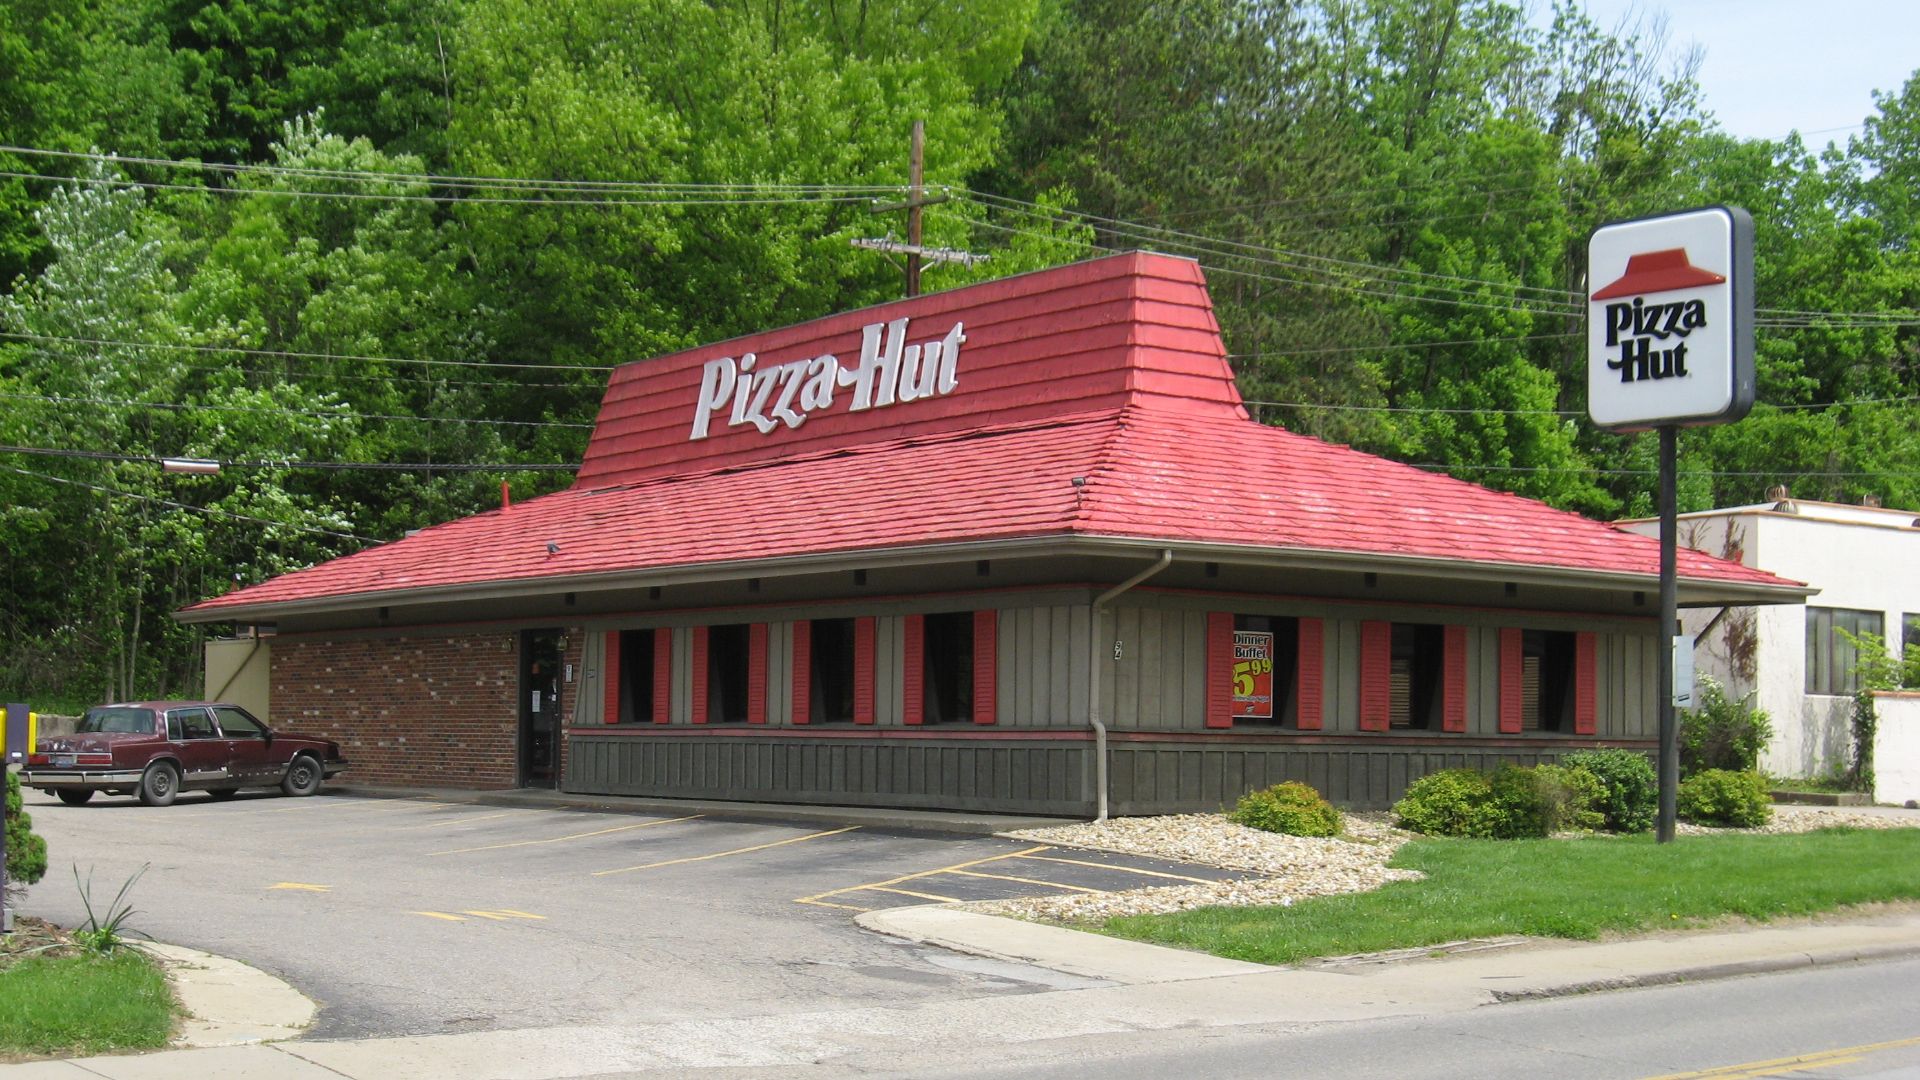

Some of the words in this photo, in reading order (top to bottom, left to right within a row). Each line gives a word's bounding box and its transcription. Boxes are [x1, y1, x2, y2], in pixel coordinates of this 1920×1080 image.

[1606, 297, 1706, 347] Pizza
[689, 353, 838, 441] Pizza
[837, 317, 967, 411] Hut
[1607, 337, 1688, 383] Hut
[1234, 633, 1268, 646] Dinner
[1234, 646, 1267, 658] Buffet
